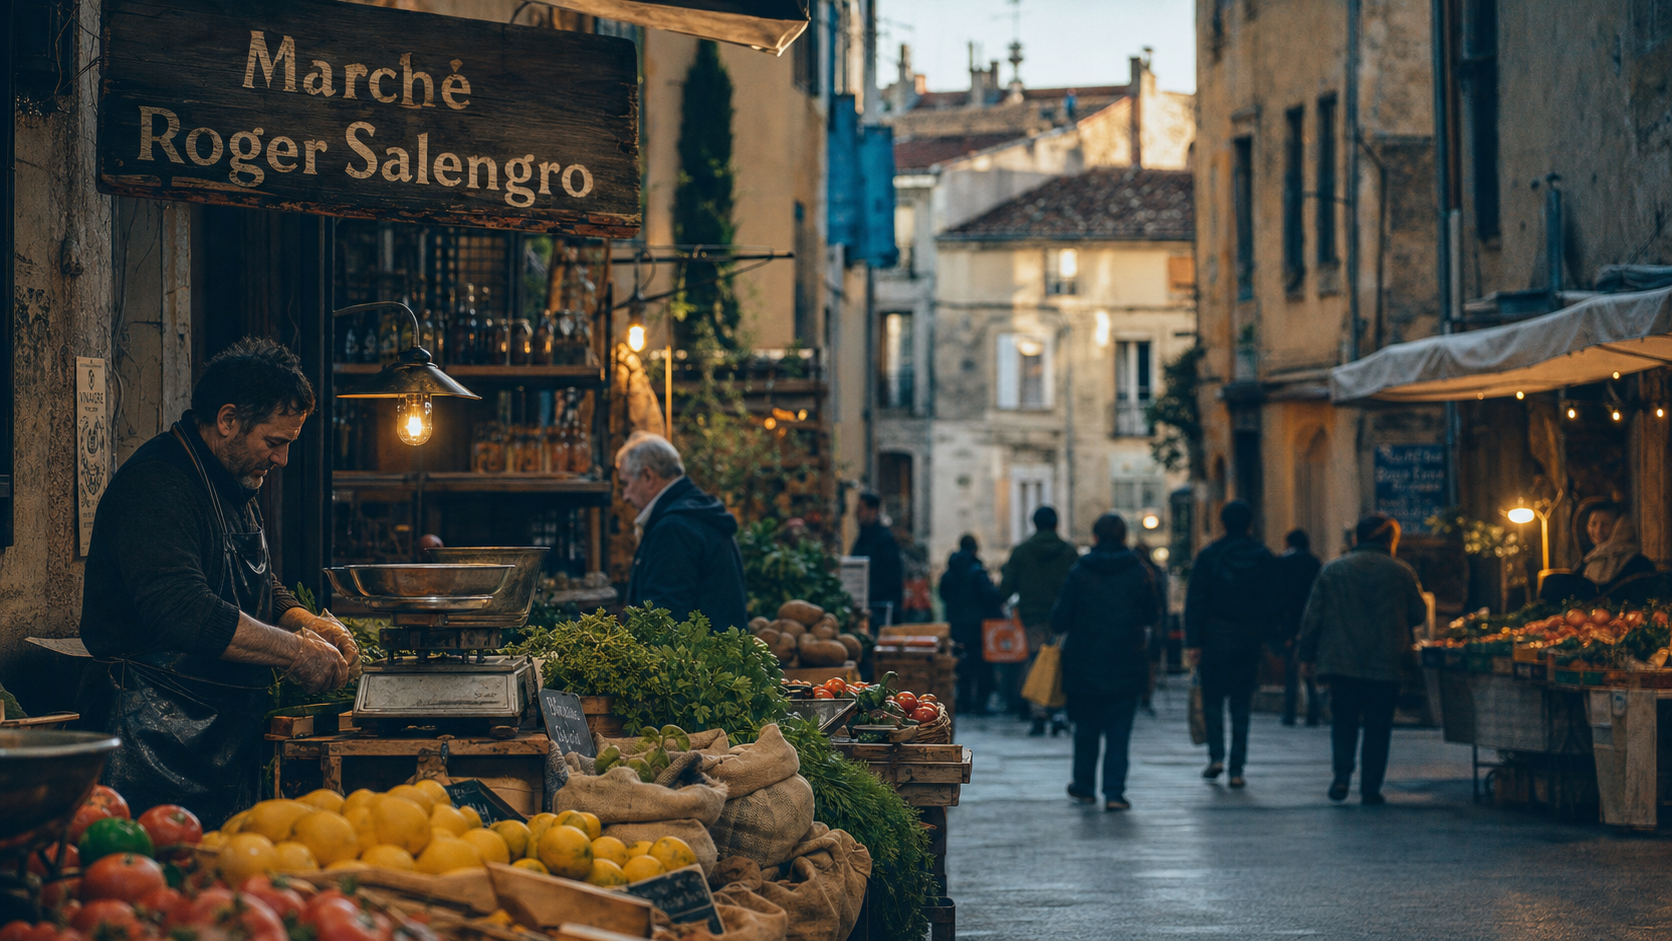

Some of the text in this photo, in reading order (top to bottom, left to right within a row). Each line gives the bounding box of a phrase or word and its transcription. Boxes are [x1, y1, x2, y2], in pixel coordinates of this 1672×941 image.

[242, 30, 472, 110] Marché
[136, 105, 594, 208] Roger Salengro
